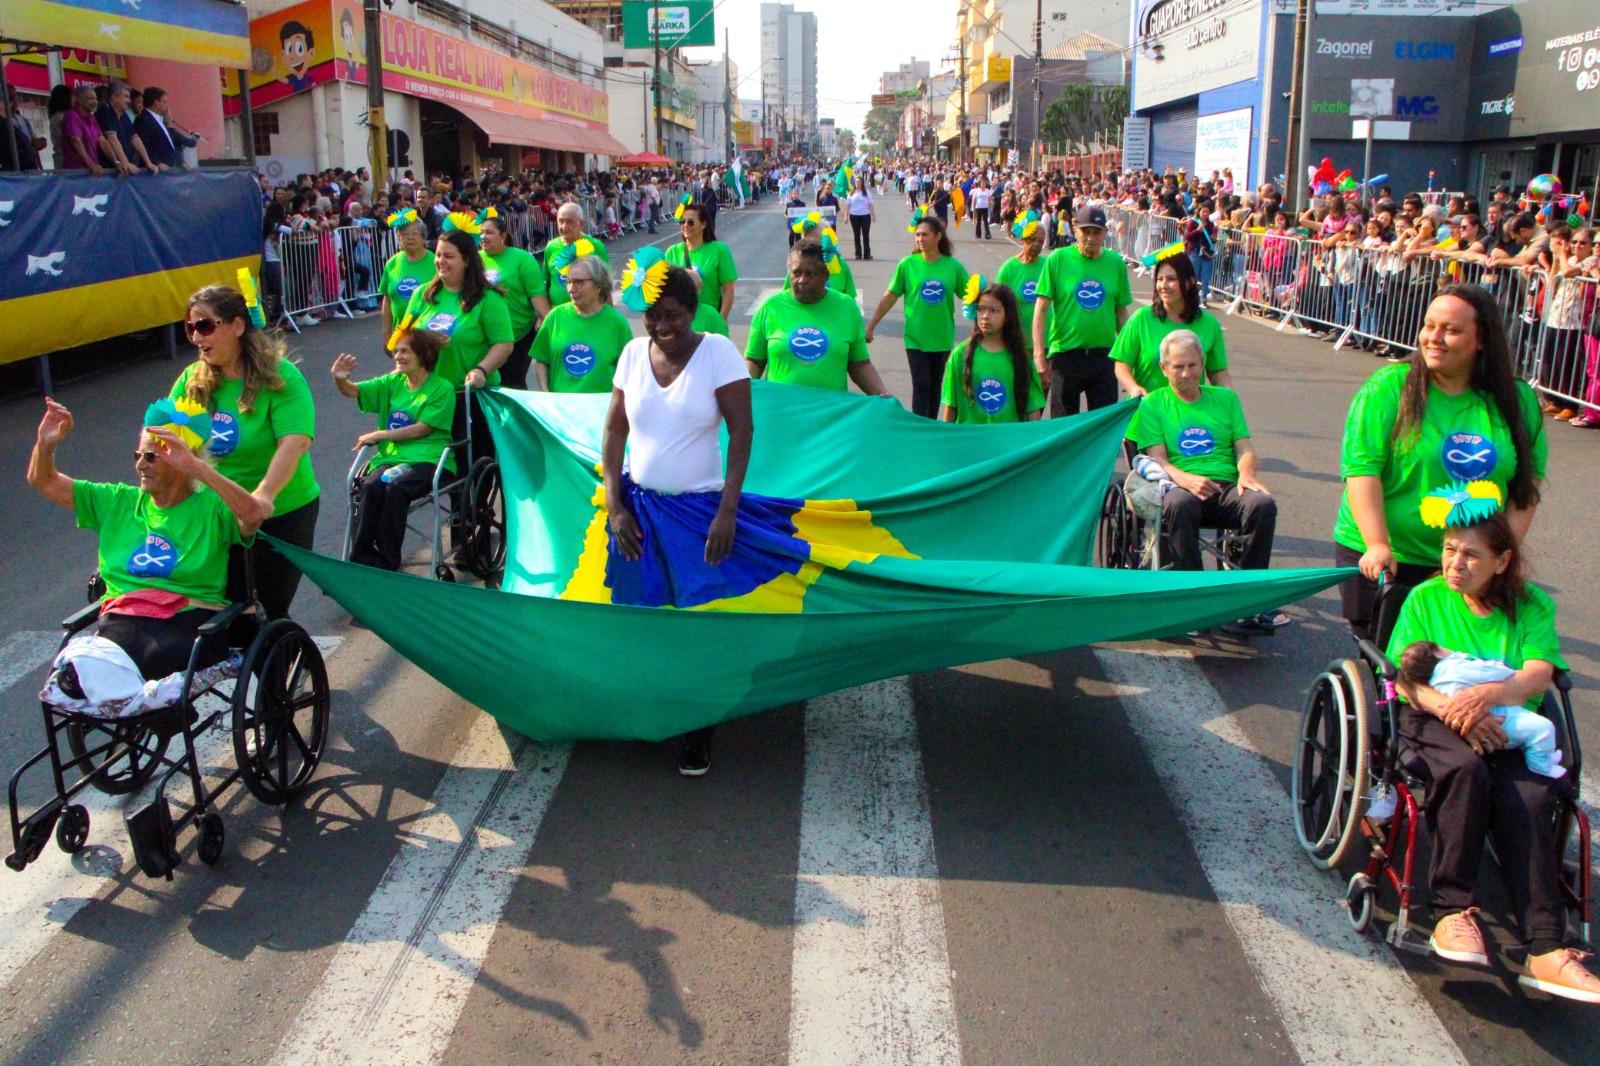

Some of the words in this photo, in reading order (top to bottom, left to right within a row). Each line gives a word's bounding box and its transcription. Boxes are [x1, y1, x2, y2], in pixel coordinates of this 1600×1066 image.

[651, 22, 685, 30] ARKA
[1316, 38, 1374, 58] Zagonel
[1394, 41, 1455, 61] ELGIN
[1545, 32, 1586, 51] MATERIAIS
[381, 15, 431, 75] LOJA
[432, 33, 472, 85] REAL
[473, 47, 505, 93] LIMA
[1311, 100, 1351, 114] intelb
[1396, 95, 1439, 116] MG
[1481, 99, 1505, 115] TIGRE
